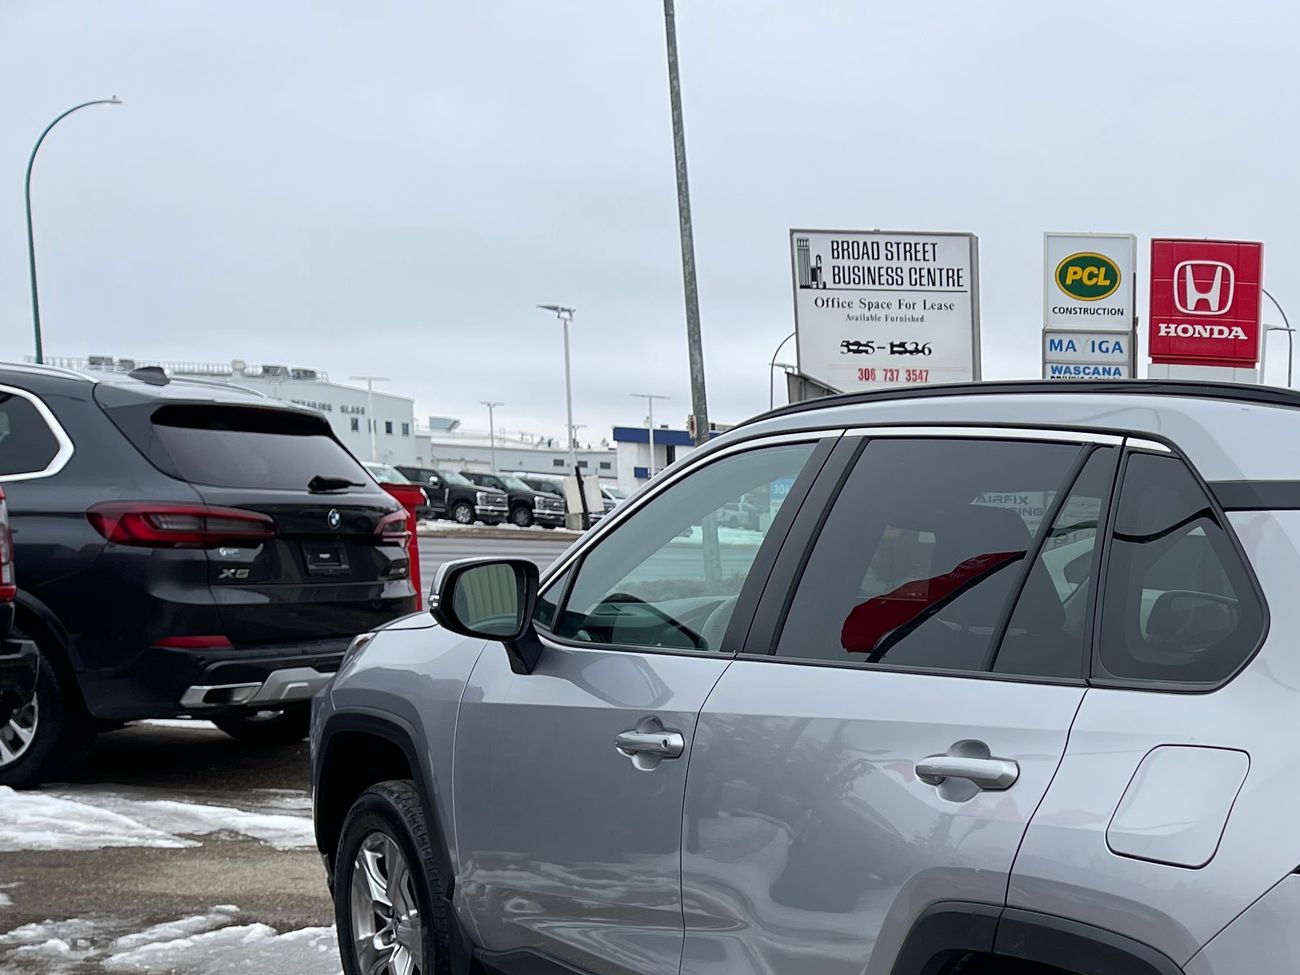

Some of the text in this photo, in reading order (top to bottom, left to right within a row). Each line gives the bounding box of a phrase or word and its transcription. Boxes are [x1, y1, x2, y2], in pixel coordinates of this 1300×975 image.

[831, 240, 938, 262] BROAD STREET
[832, 265, 964, 288] BUSINESS CENTRE
[1065, 266, 1112, 286] PCL
[814, 296, 955, 312] Office Space For Lease
[1052, 306, 1124, 316] CONSTRUCTION
[845, 313, 925, 323] Available Furnished
[1158, 323, 1248, 340] HONDA
[858, 368, 929, 383] 306 737 3547
[1050, 365, 1122, 377] WASCANA
